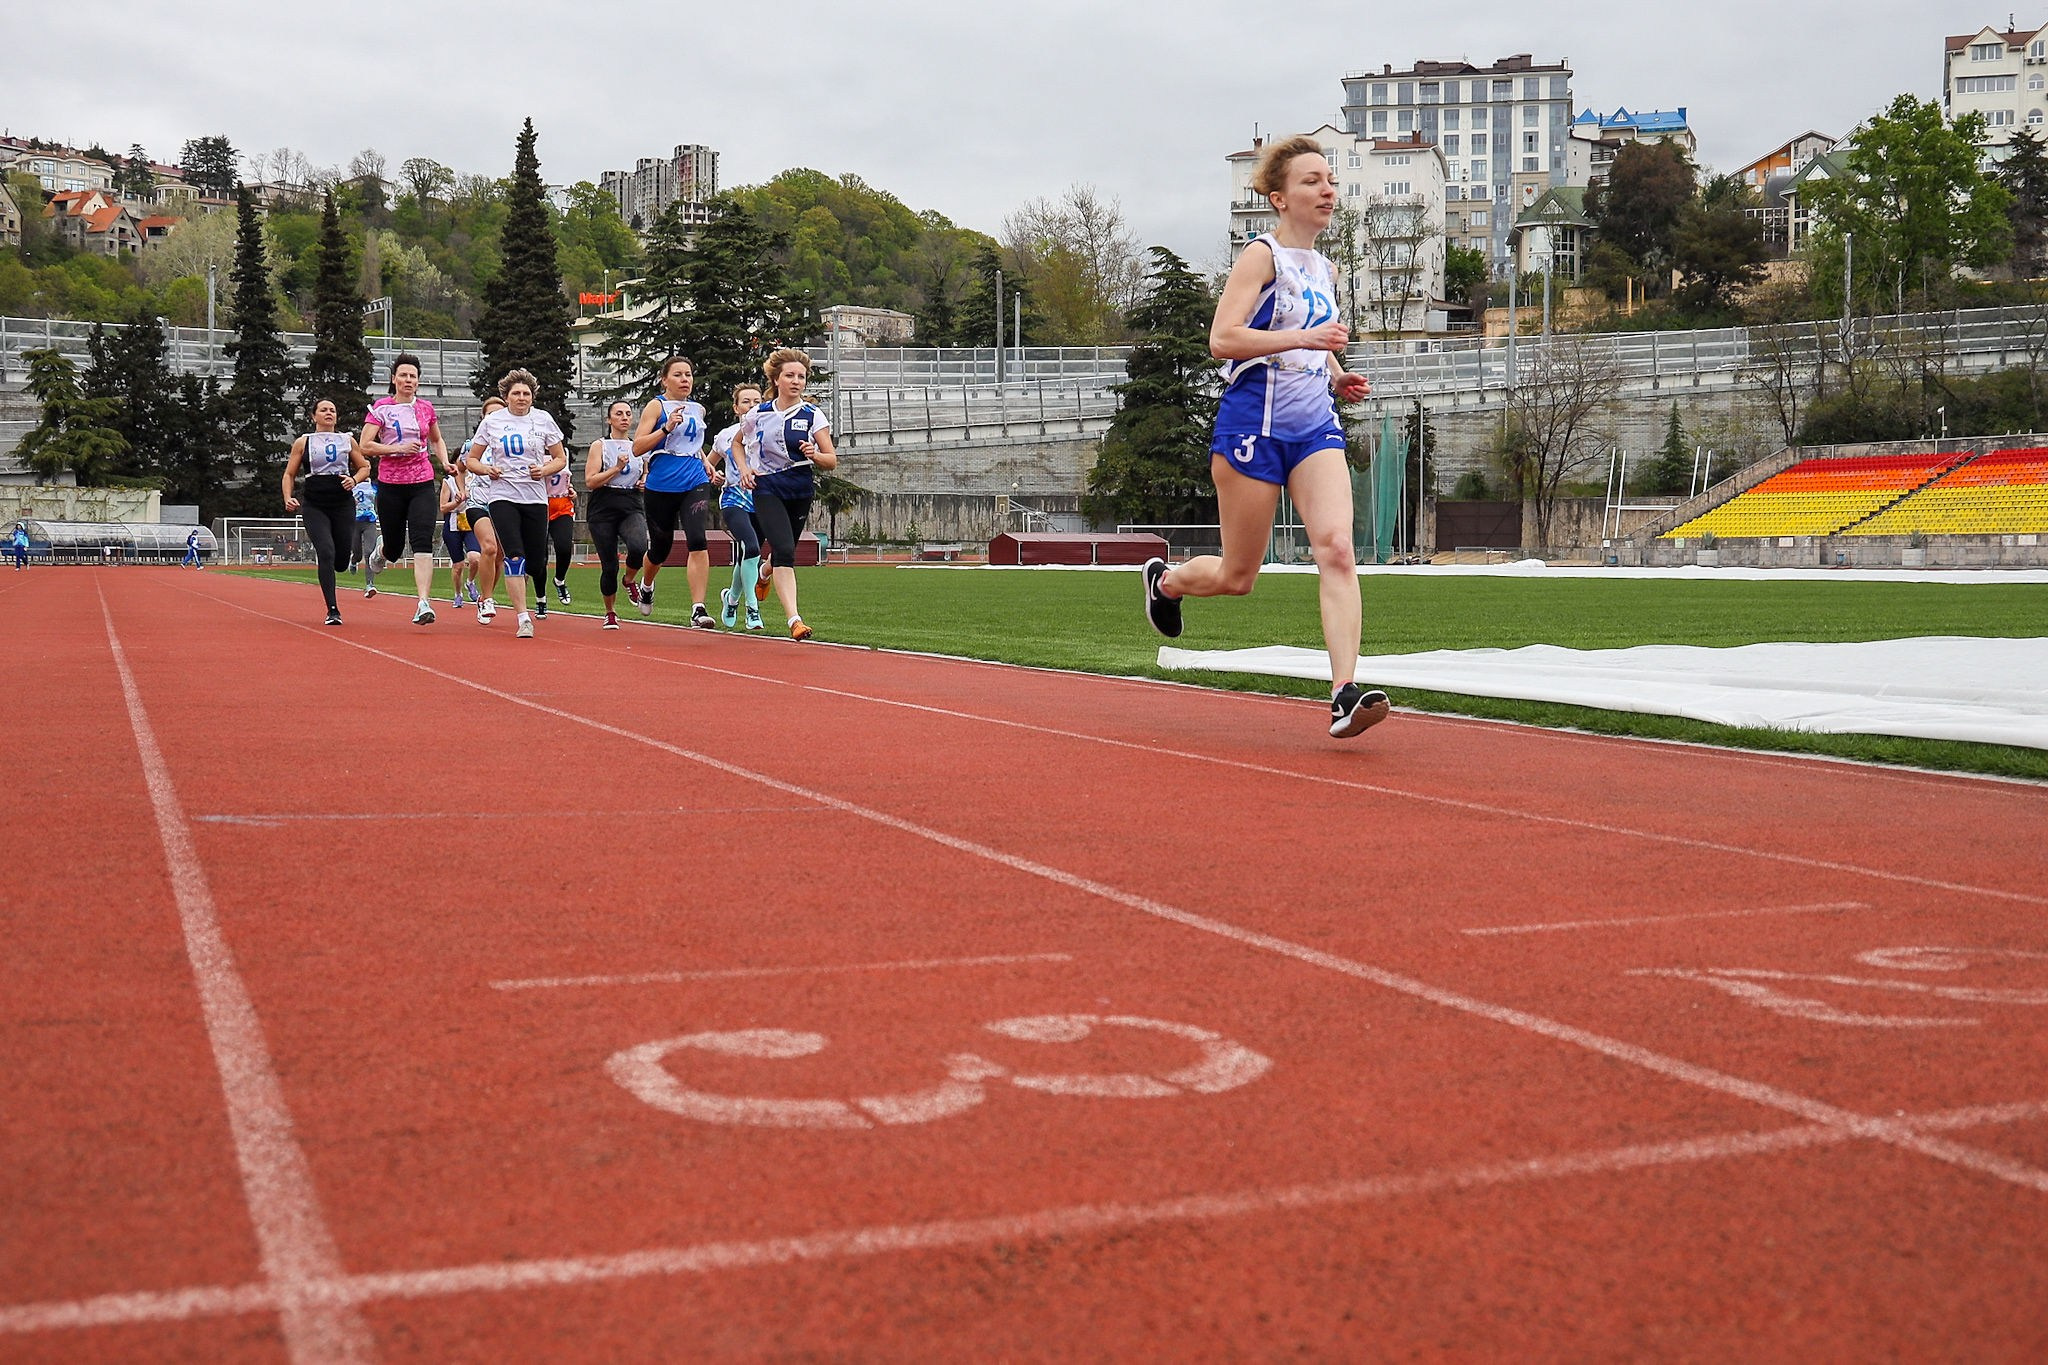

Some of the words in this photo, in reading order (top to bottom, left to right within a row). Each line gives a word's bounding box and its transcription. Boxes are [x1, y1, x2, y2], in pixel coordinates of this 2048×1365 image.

[391, 419, 403, 442] 1
[684, 416, 697, 443] 4
[324, 443, 337, 463] 9
[499, 433, 525, 458] 10
[1233, 433, 1257, 463] 3
[604, 1013, 1273, 1129] 3
